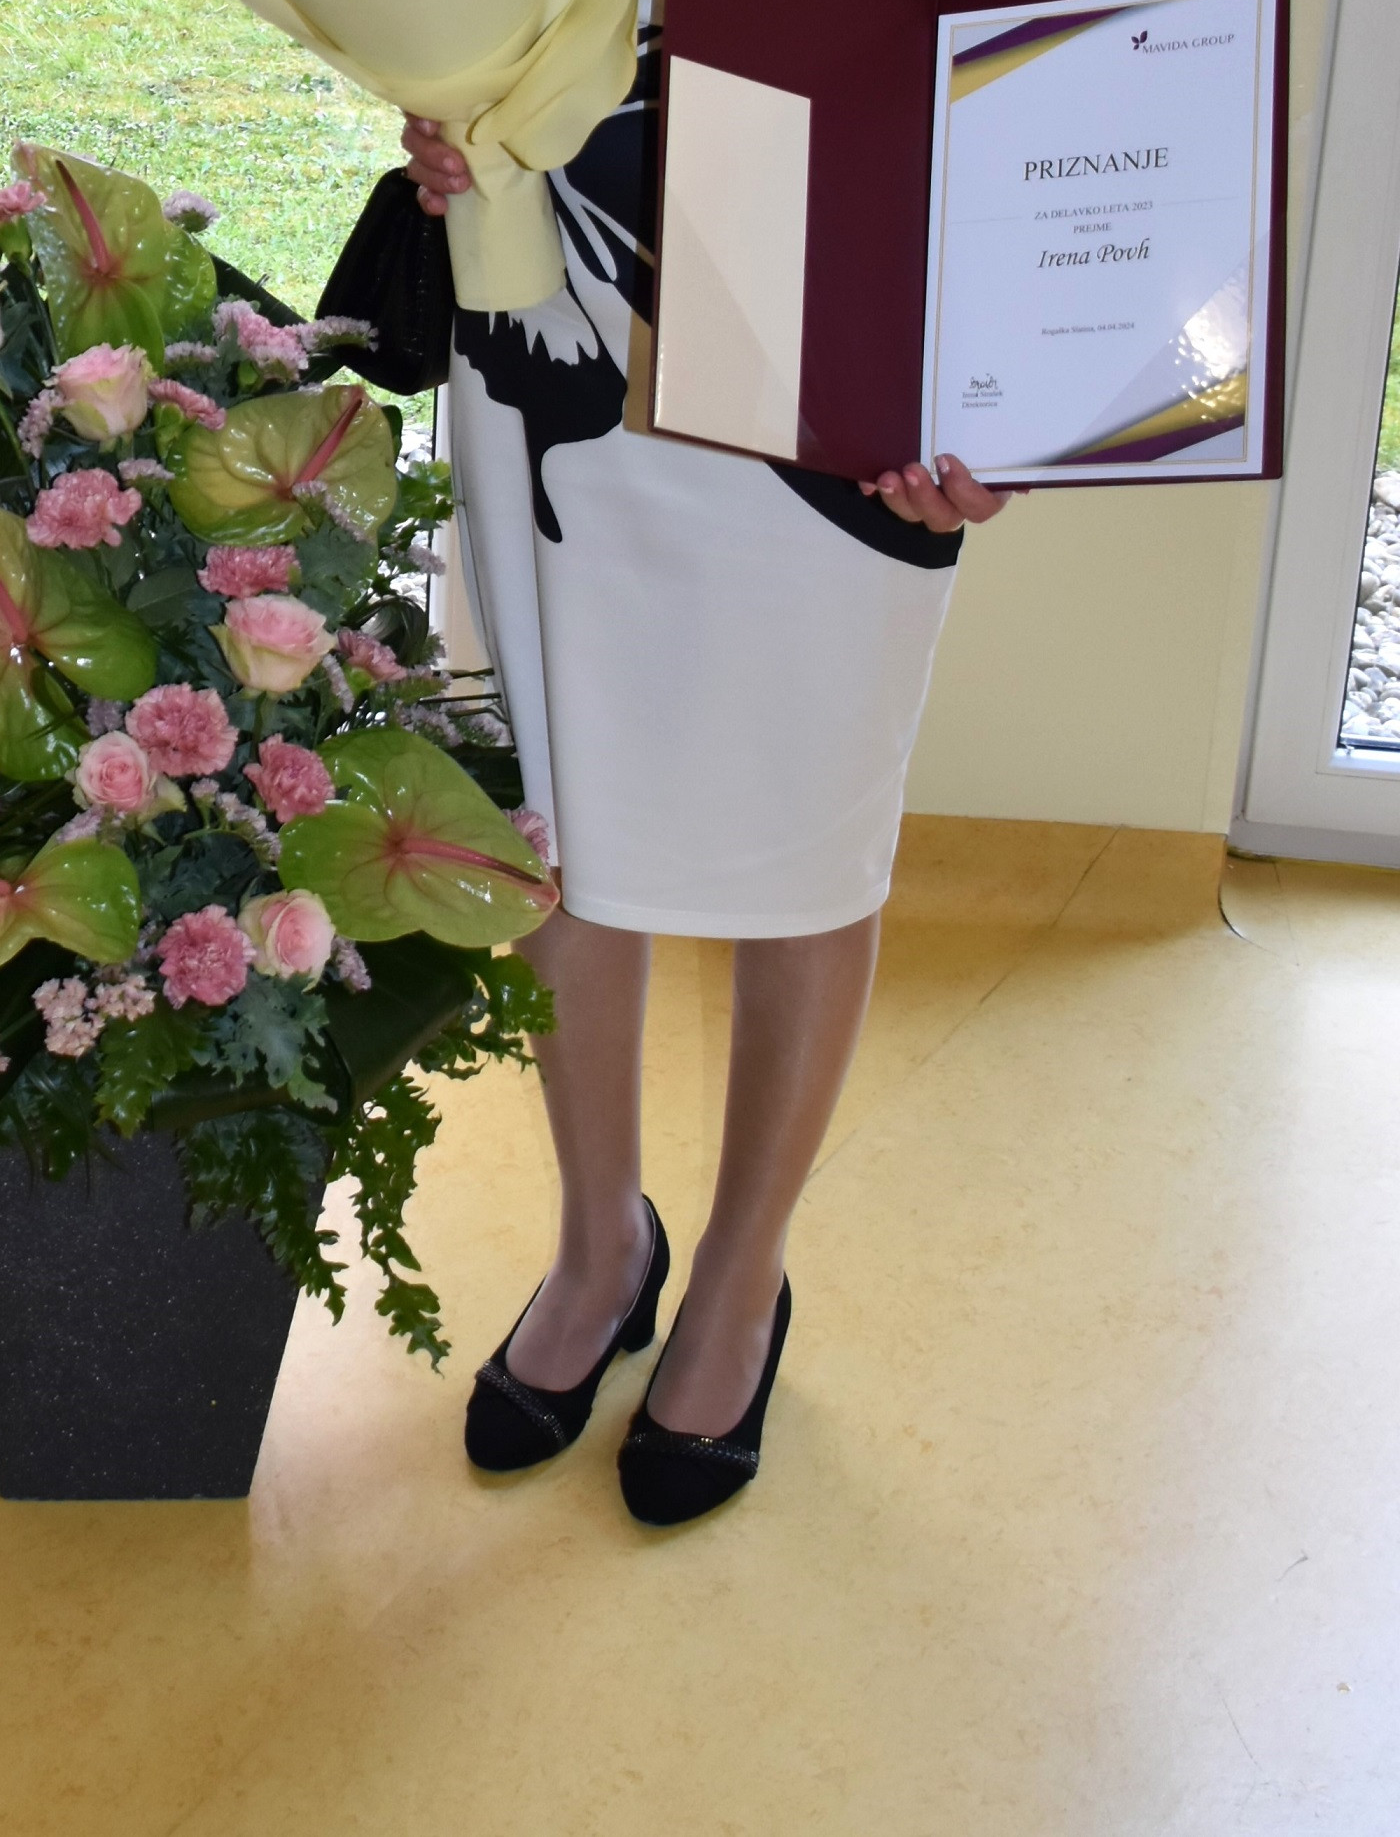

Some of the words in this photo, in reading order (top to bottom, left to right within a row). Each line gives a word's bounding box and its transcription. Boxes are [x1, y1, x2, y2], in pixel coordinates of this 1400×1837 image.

[1142, 41, 1188, 55] MAVIDA
[1192, 34, 1235, 49] GROUP
[1024, 147, 1169, 181] PRIZNANJE
[1034, 210, 1049, 220] ZA
[1050, 206, 1101, 219] DELAVKO
[1103, 203, 1130, 214] LETA
[1132, 200, 1153, 211] 2023
[1073, 222, 1112, 234] PREJME
[1037, 250, 1091, 268] Irena
[1097, 237, 1150, 264] Povh
